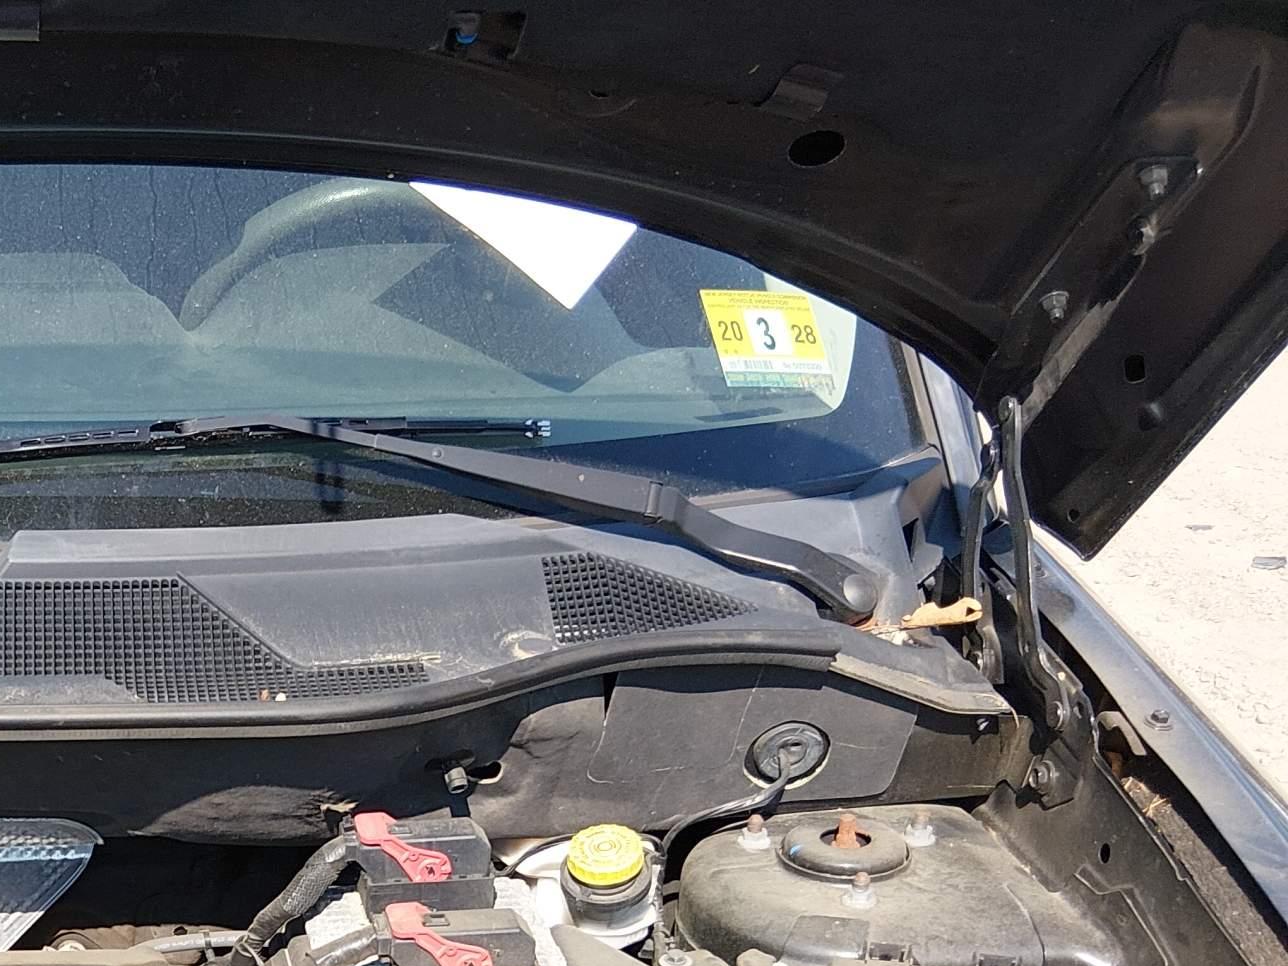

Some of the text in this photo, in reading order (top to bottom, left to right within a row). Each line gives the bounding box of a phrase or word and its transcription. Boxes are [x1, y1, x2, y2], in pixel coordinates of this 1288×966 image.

[718, 317, 816, 350] 20 3 28
